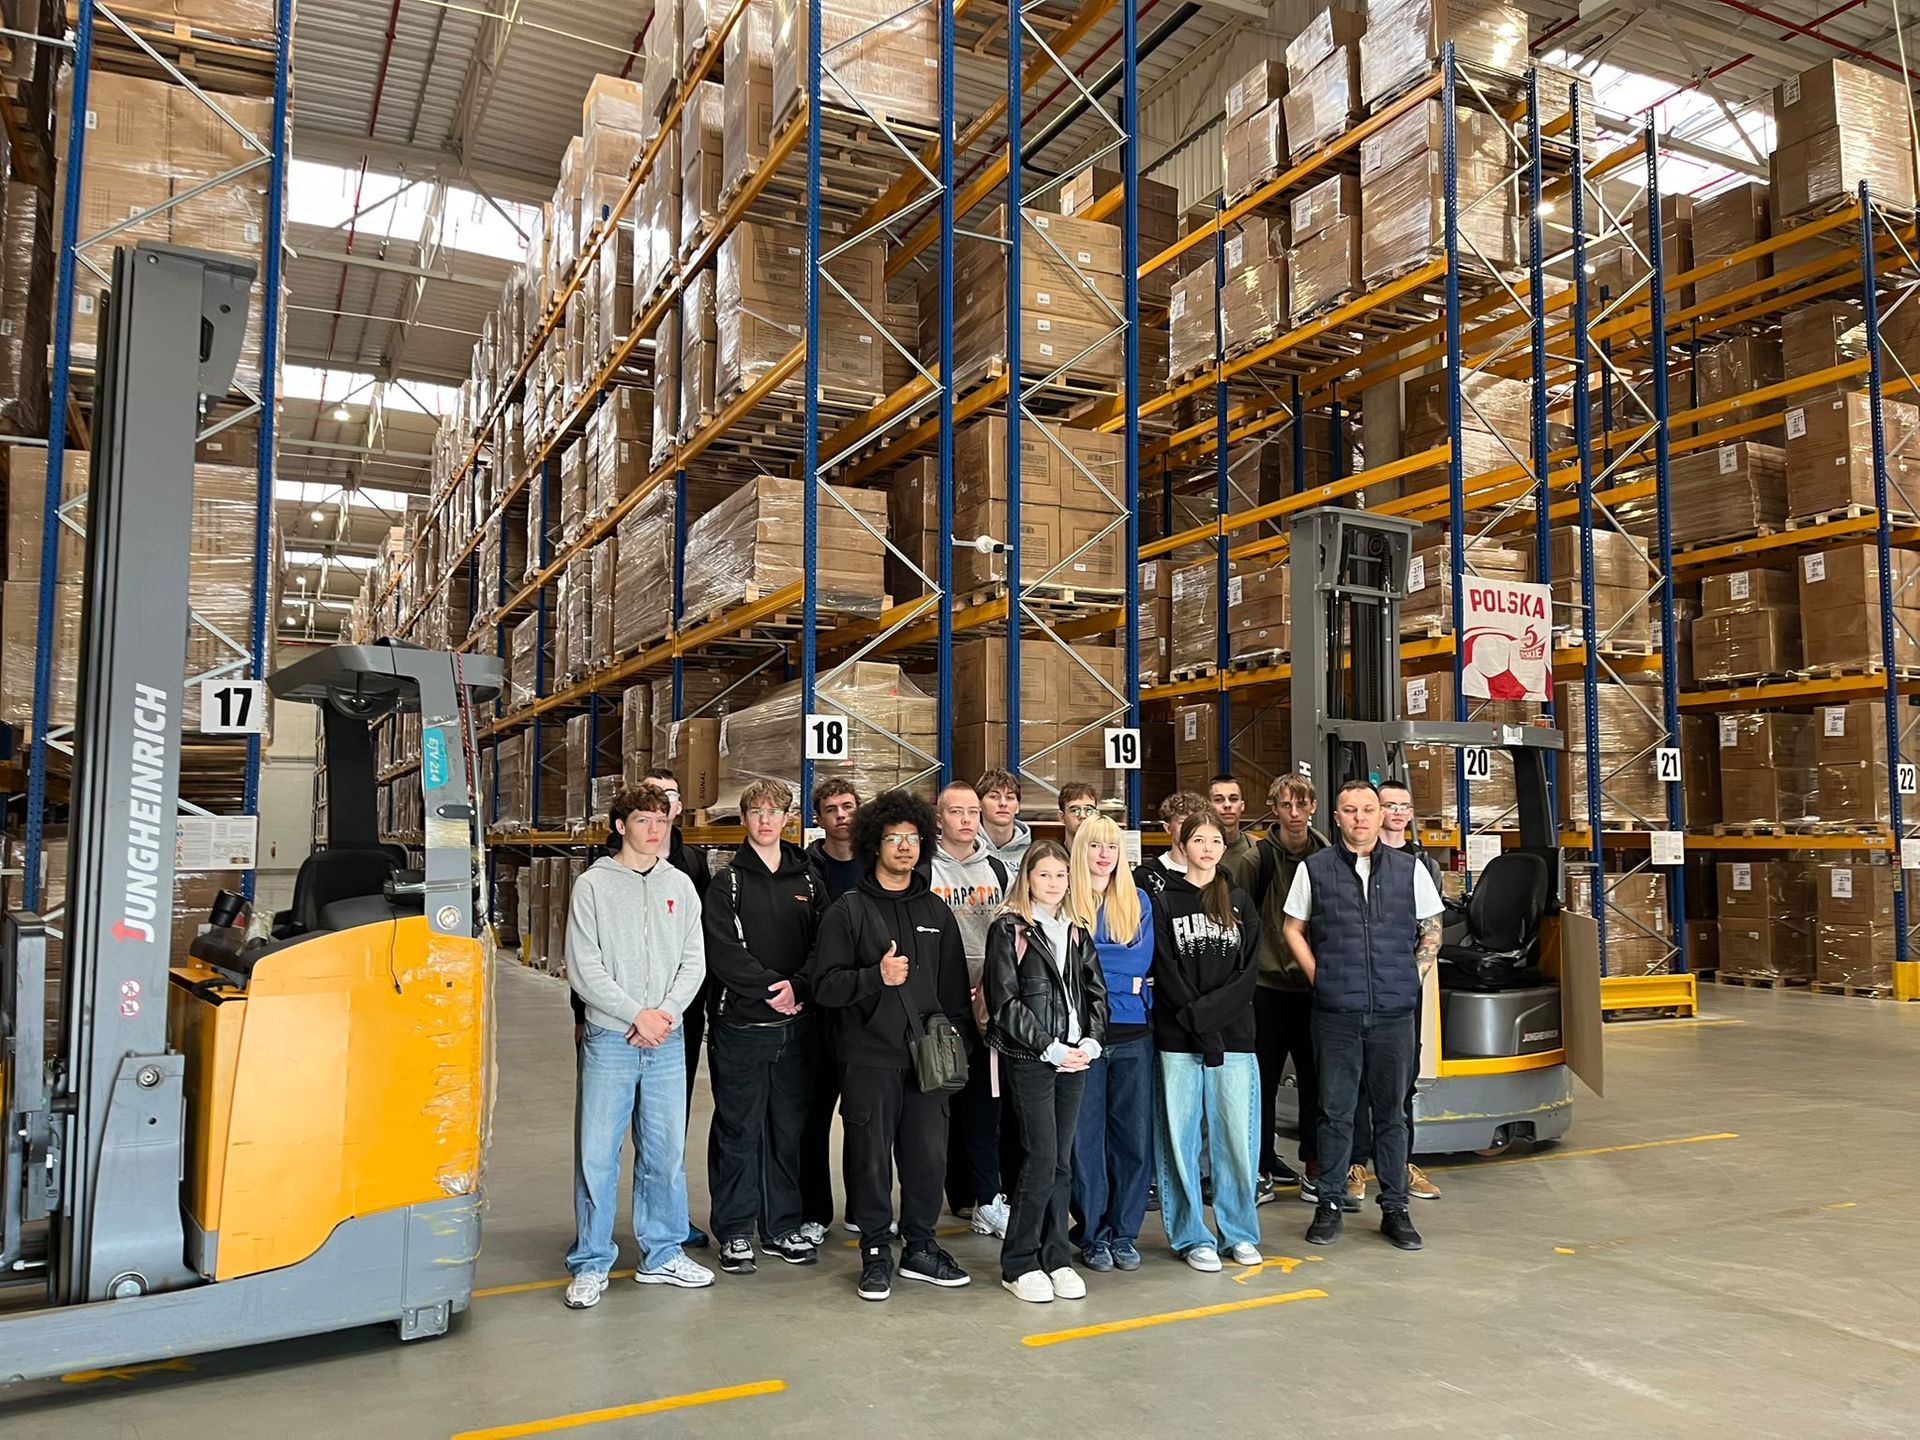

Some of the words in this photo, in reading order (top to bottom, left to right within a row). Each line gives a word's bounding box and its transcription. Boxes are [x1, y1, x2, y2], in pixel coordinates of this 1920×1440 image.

[1469, 588, 1545, 620] POLSKA
[213, 687, 253, 727] 17
[812, 720, 843, 755] 18
[1110, 733, 1137, 764] 19
[429, 761, 441, 783] 214
[1467, 748, 1488, 776] 20
[1661, 752, 1678, 778] 21
[1899, 768, 1915, 791] 22
[123, 682, 168, 944] JUNGHEINRICH
